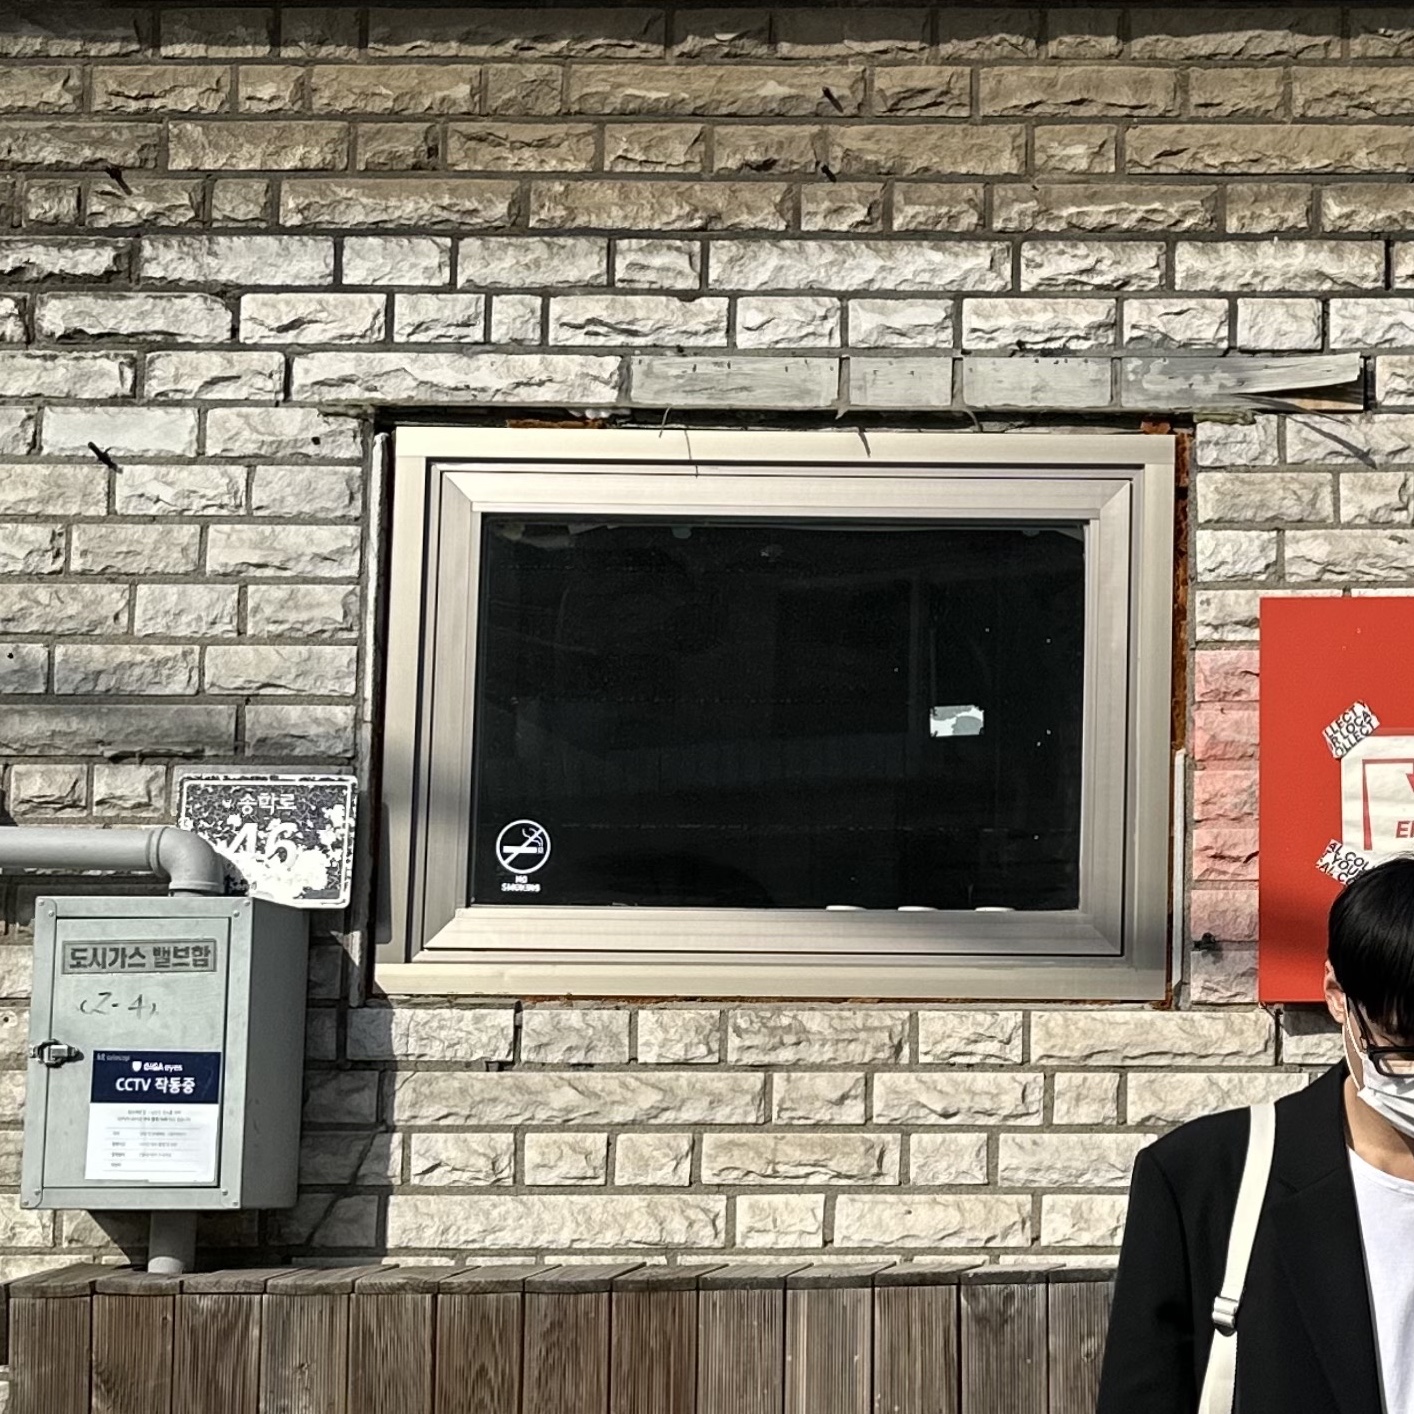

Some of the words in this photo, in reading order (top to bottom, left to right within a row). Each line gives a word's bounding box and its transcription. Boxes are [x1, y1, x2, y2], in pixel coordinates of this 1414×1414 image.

[237, 792, 297, 815] 송학로
[515, 875, 528, 884] NO
[69, 946, 146, 970] 도시가스
[115, 1078, 152, 1091] CCTV
[154, 1076, 196, 1094] 작동중
